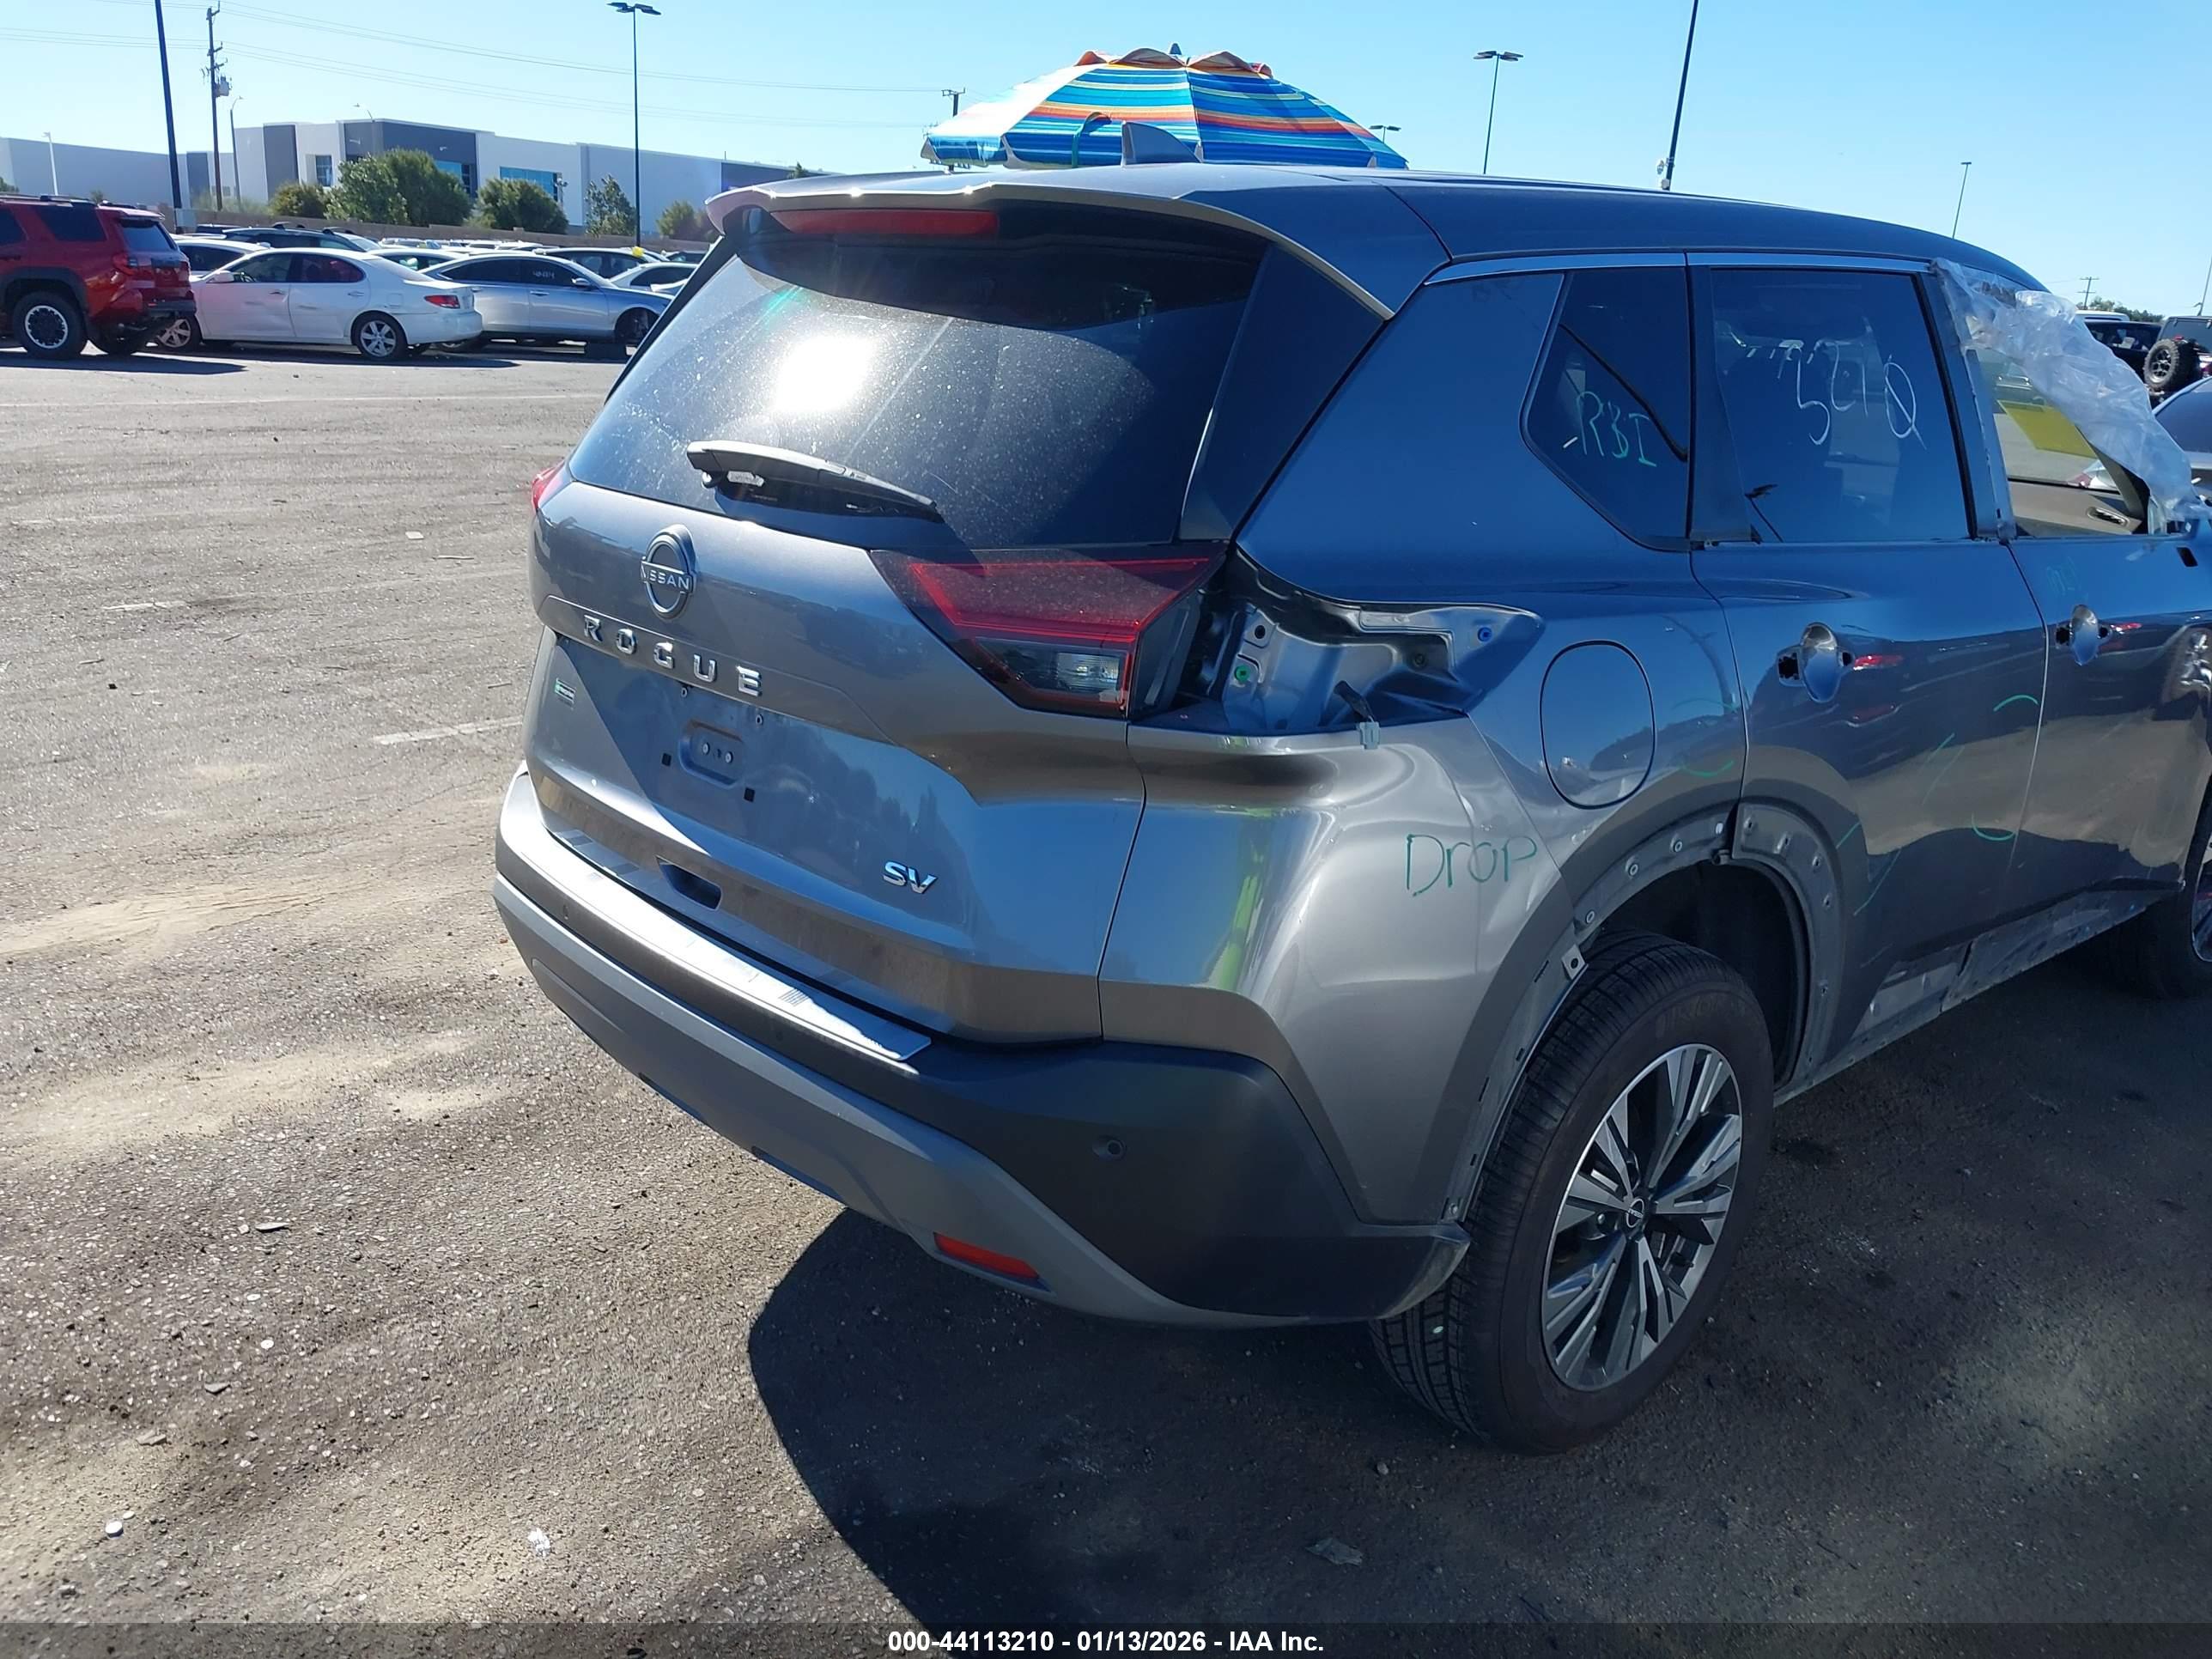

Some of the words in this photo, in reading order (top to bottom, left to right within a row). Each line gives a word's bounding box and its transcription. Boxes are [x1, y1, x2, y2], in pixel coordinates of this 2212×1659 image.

[641, 562, 690, 591] NISSAN
[583, 614, 763, 697] ROGUE
[883, 861, 938, 894] SV
